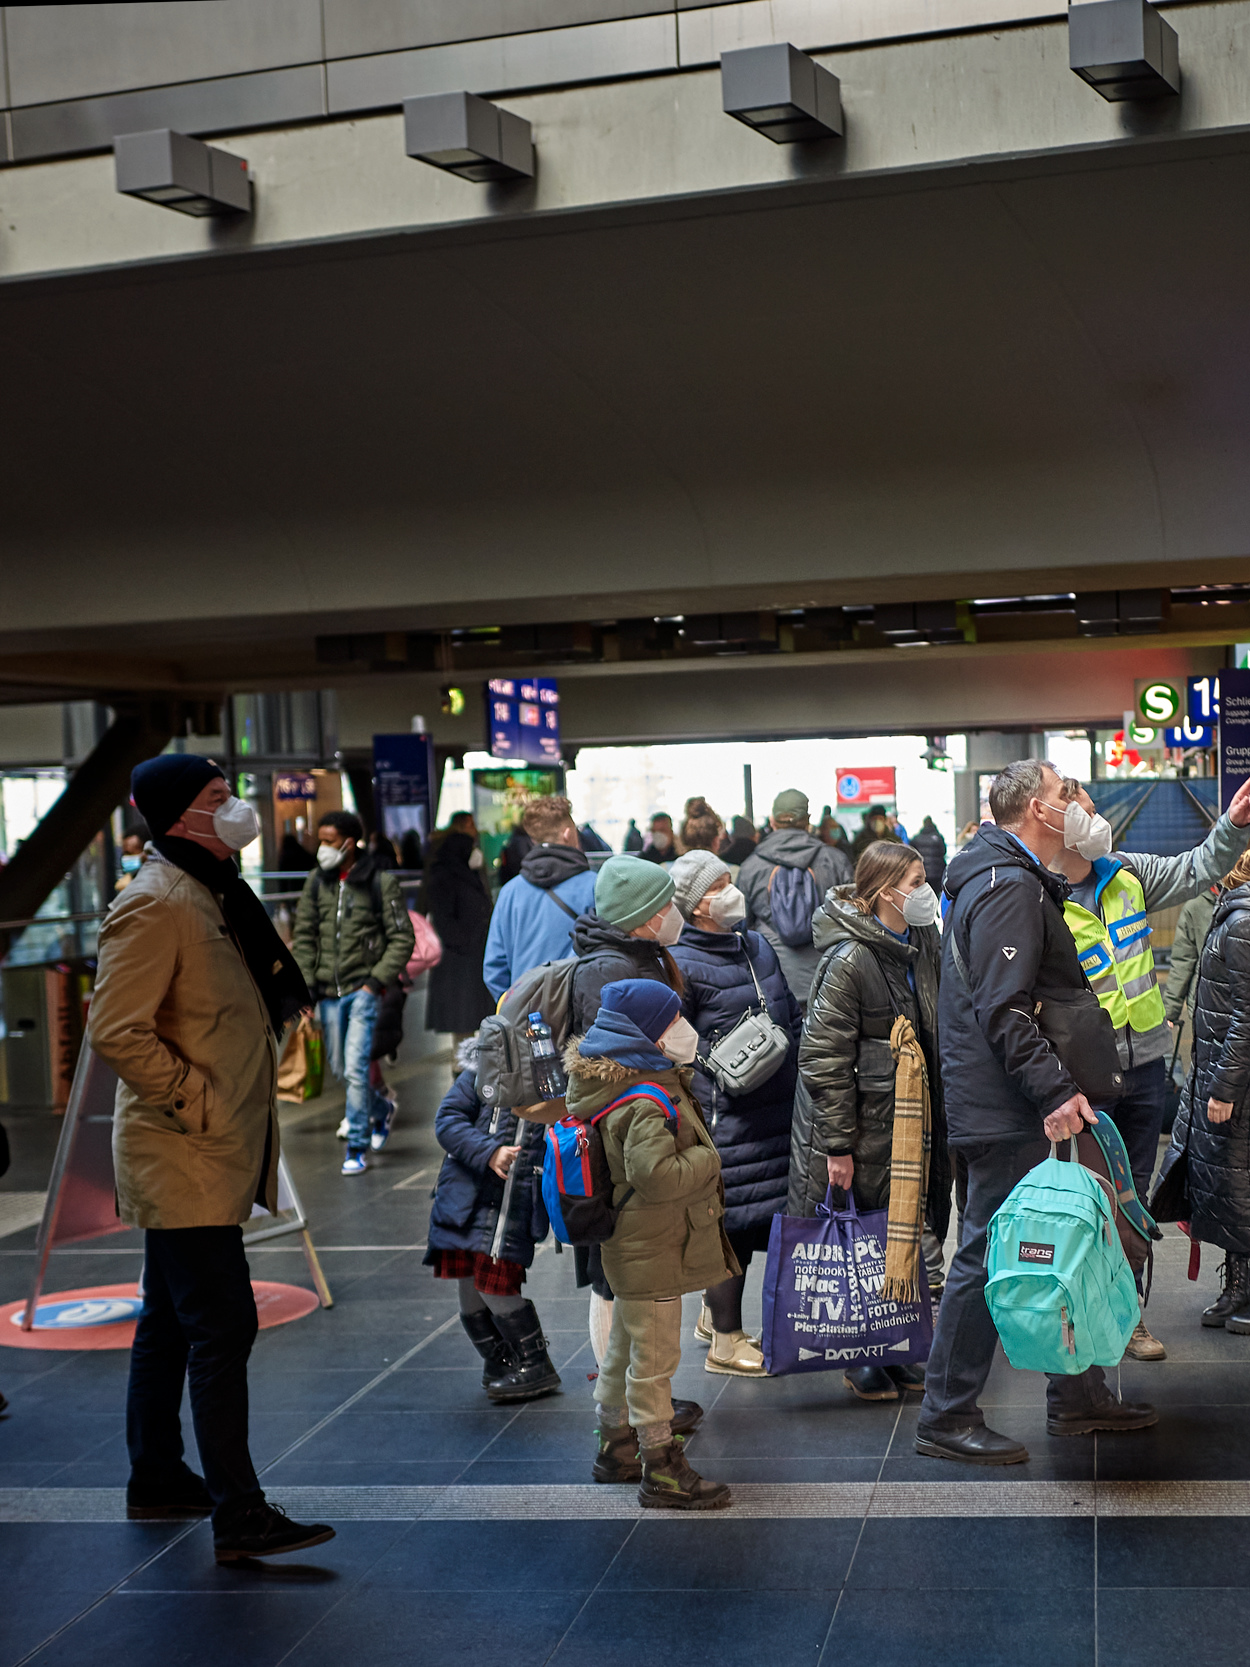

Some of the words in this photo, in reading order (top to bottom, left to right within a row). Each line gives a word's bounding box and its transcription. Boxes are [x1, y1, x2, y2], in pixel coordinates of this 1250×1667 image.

[1145, 685, 1174, 720] S
[794, 1274, 840, 1293] iMac
[807, 1297, 845, 1320] TV
[868, 1302, 898, 1318] FOTO
[794, 1321, 859, 1334] PlayStation
[870, 1312, 920, 1331] chladničky
[825, 1343, 889, 1361] DATART
